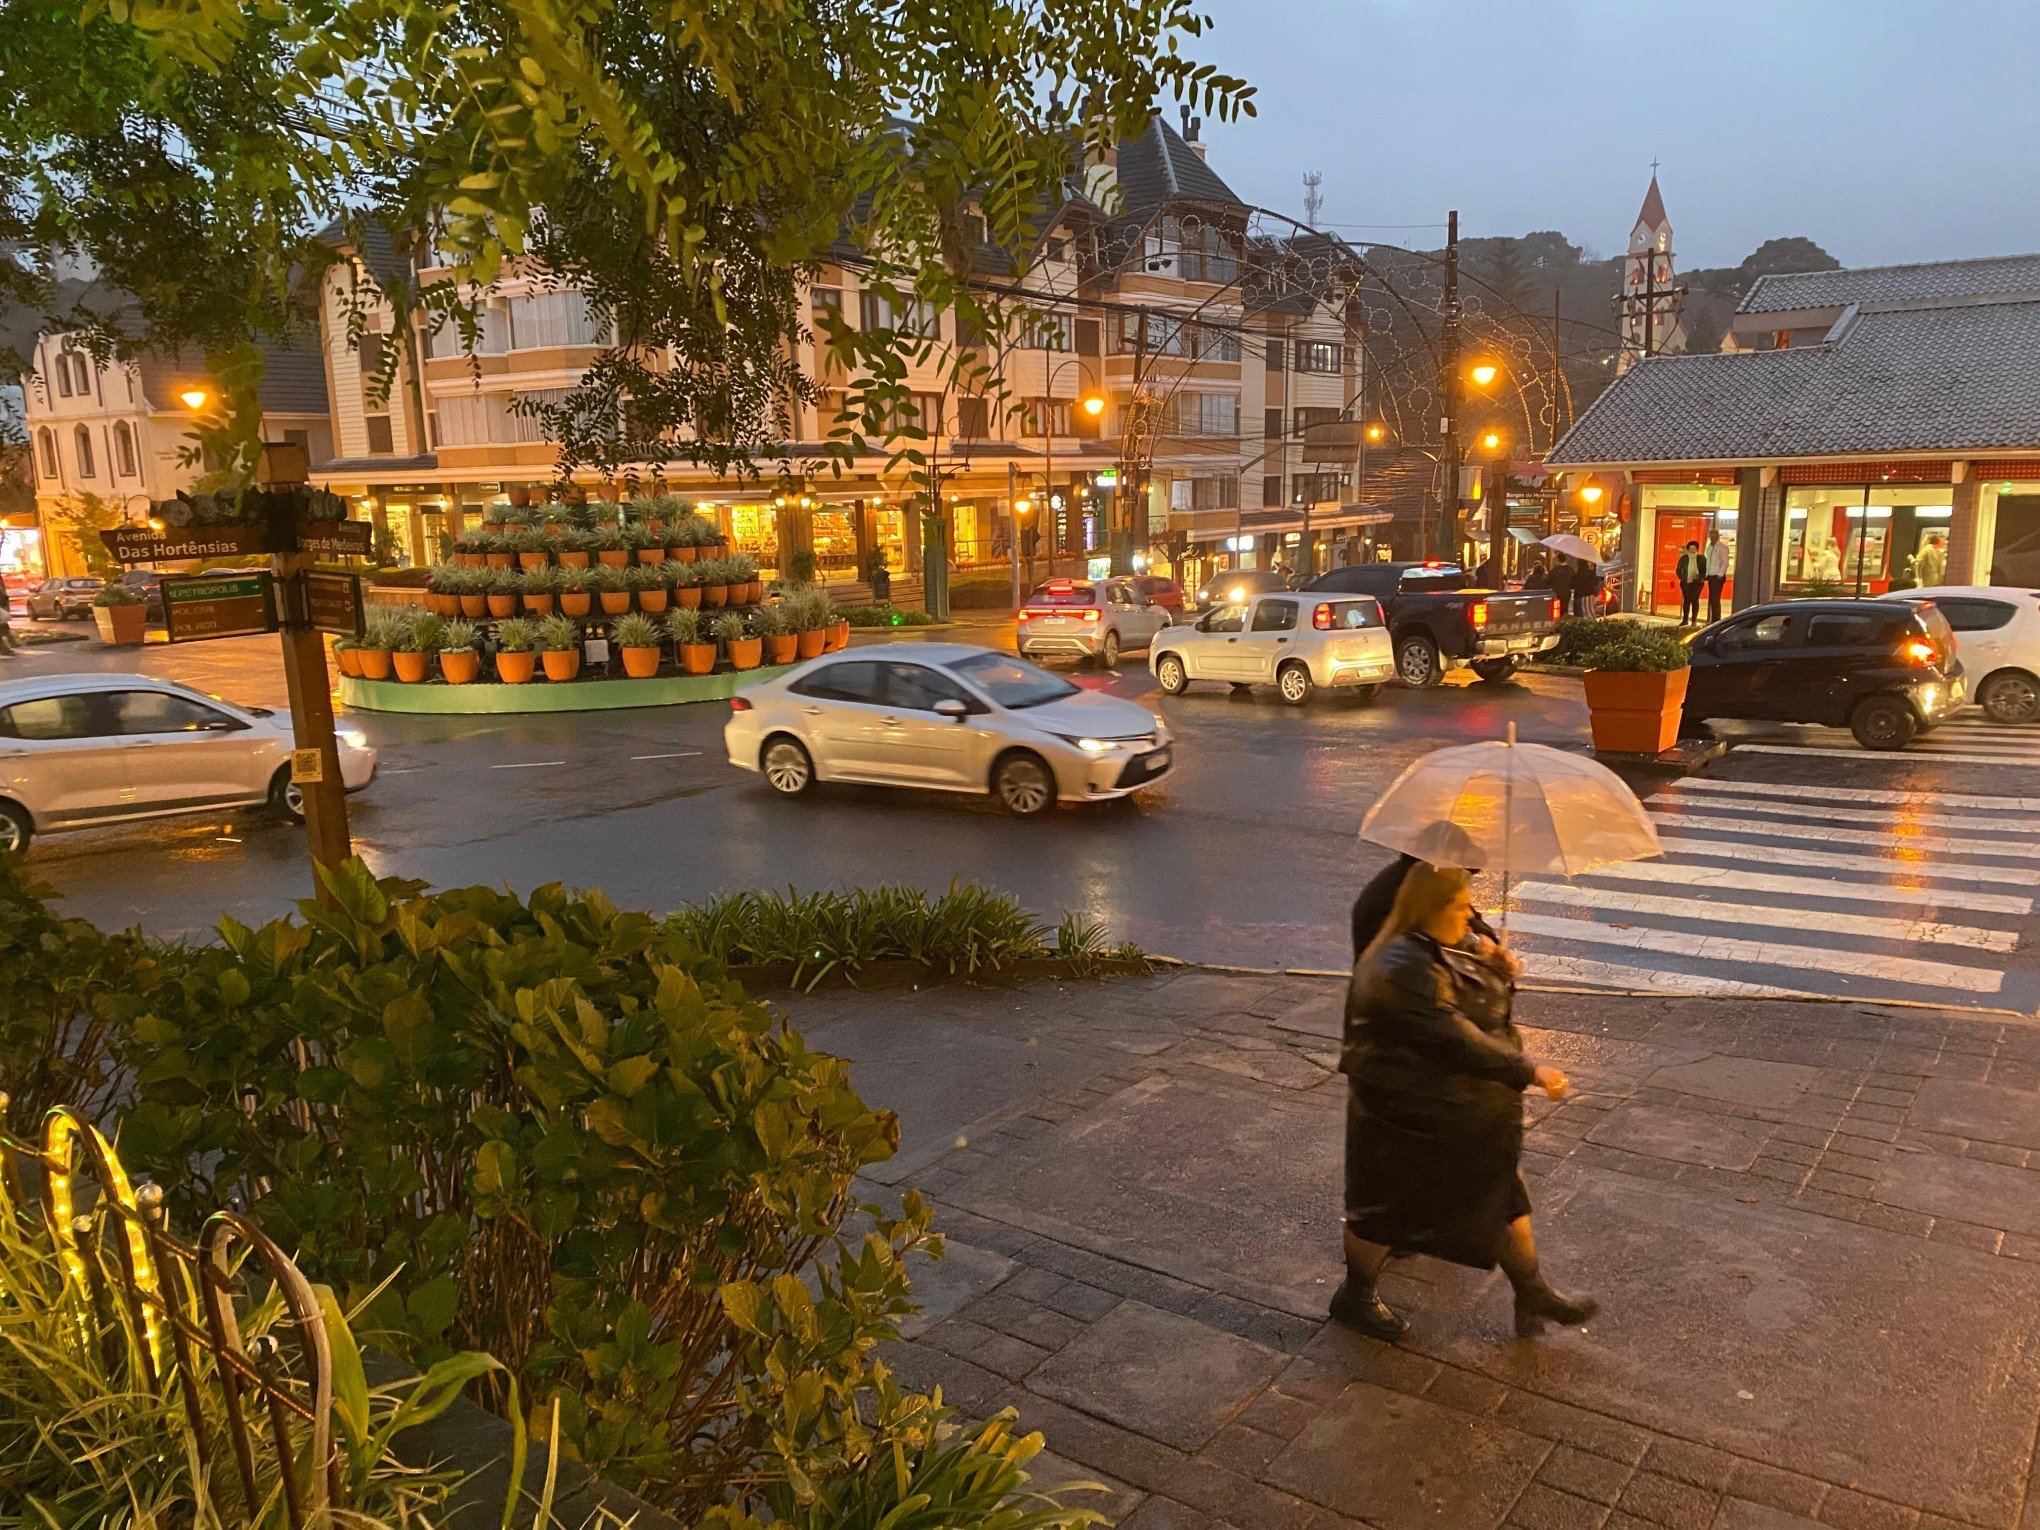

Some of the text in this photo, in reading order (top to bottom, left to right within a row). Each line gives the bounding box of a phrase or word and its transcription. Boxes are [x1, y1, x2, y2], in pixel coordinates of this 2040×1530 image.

[116, 530, 167, 542] Avenida
[1587, 535, 1593, 543] E
[119, 541, 238, 559] Das Hortênsias
[296, 536, 365, 552] Borges de Medeiros
